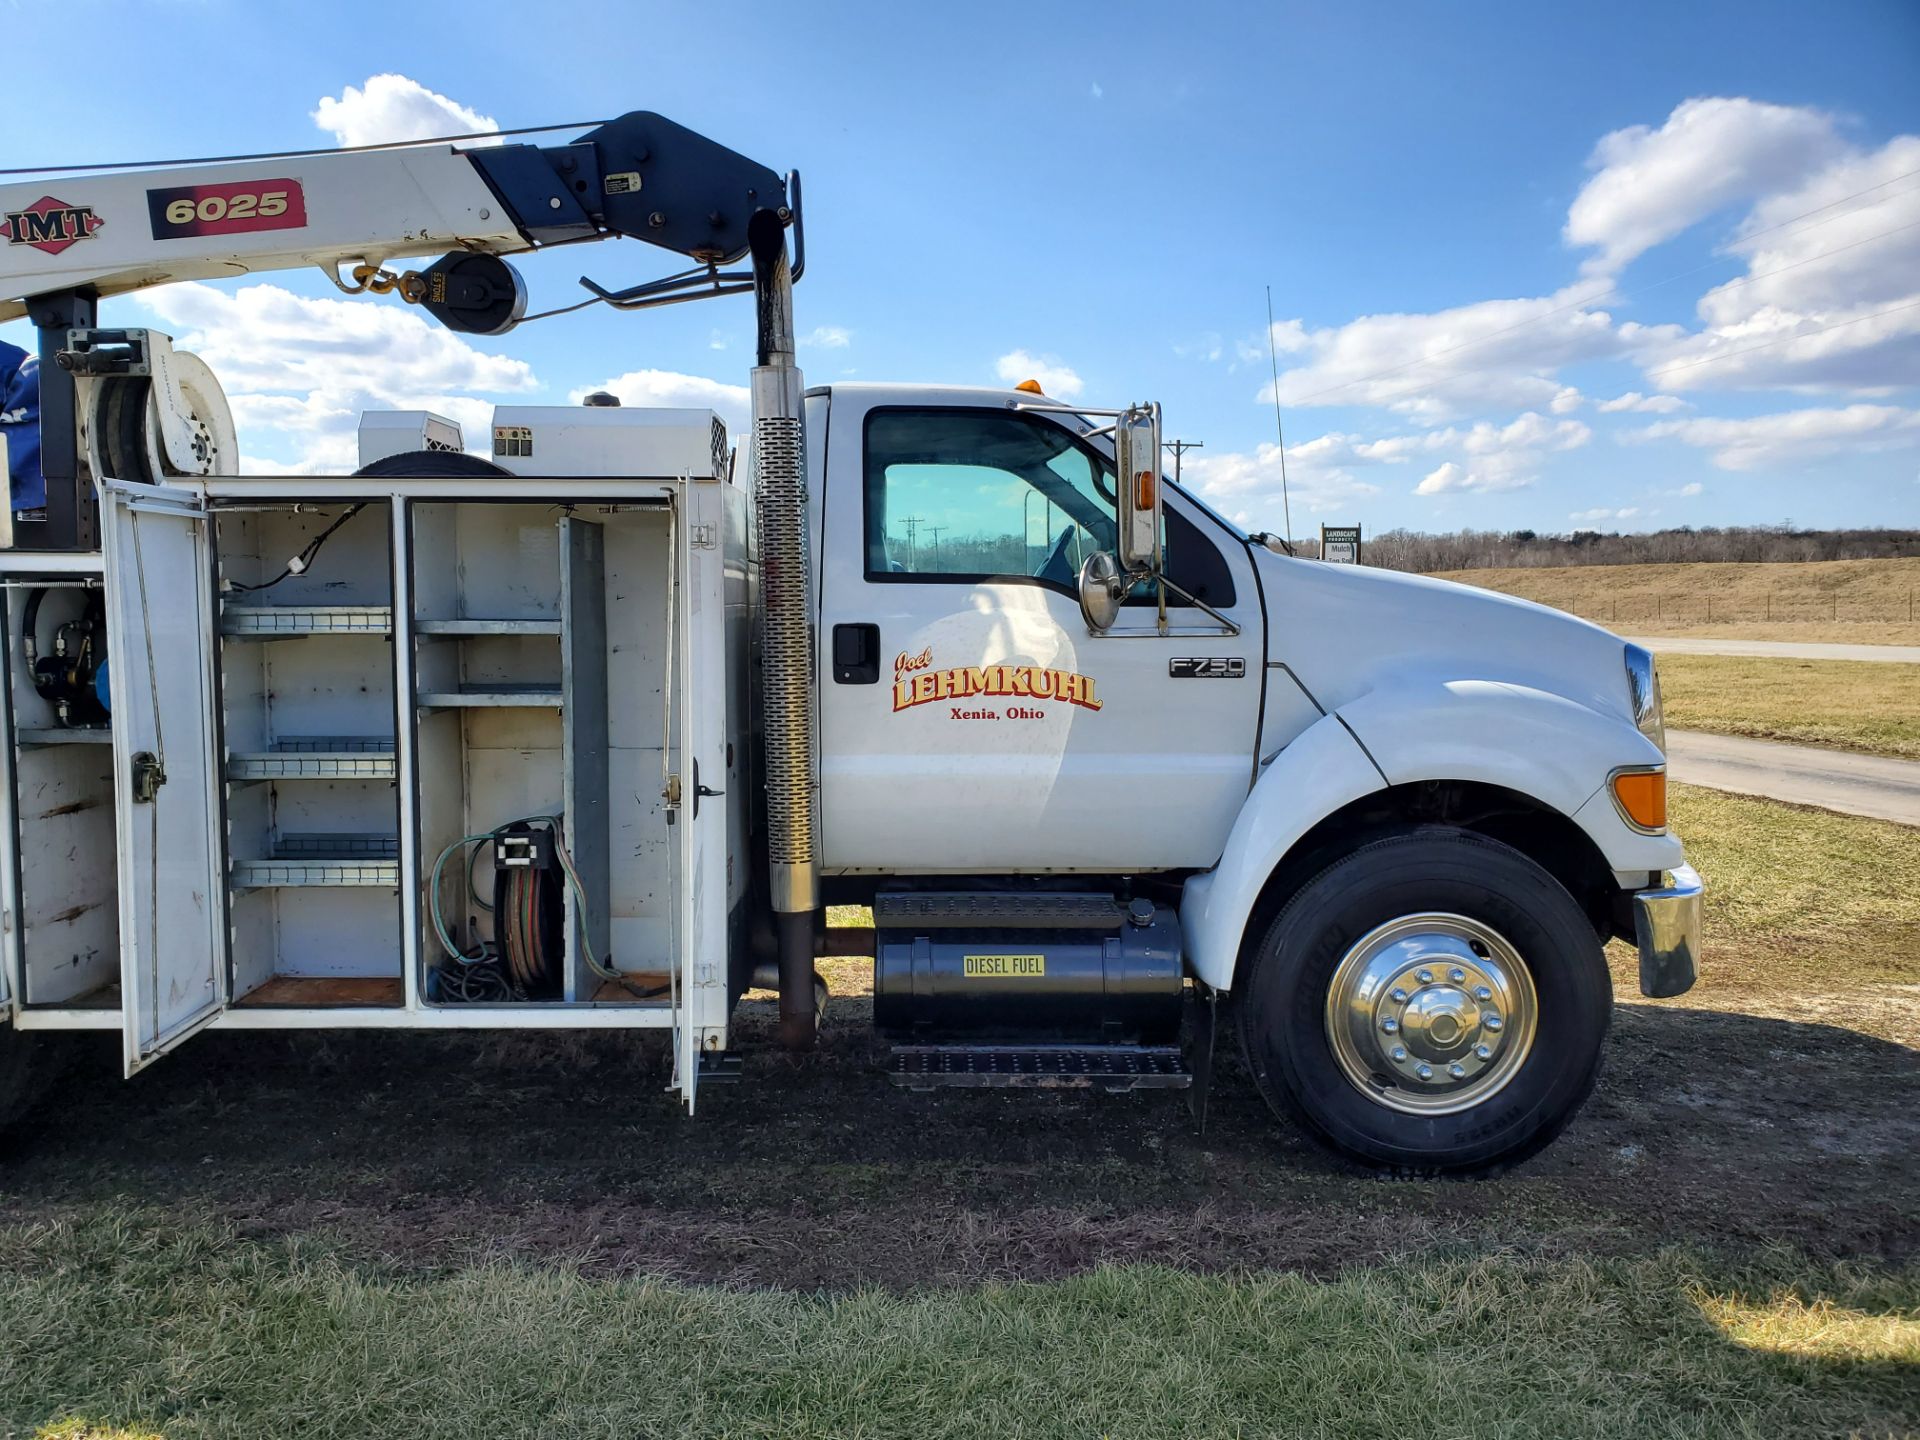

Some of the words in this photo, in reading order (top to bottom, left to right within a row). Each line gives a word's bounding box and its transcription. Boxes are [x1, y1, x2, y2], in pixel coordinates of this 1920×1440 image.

[165, 191, 288, 224] 6025
[5, 206, 94, 245] IMT
[432, 284, 441, 303] TONS
[1331, 544, 1350, 552] Mulch
[894, 646, 933, 682] Joel
[892, 665, 1104, 713] LEHMKUHL
[950, 708, 1000, 721] Xenia,
[1006, 707, 1045, 720] Ohio
[966, 958, 1009, 974] DIESEL
[1012, 958, 1042, 973] FUEL
